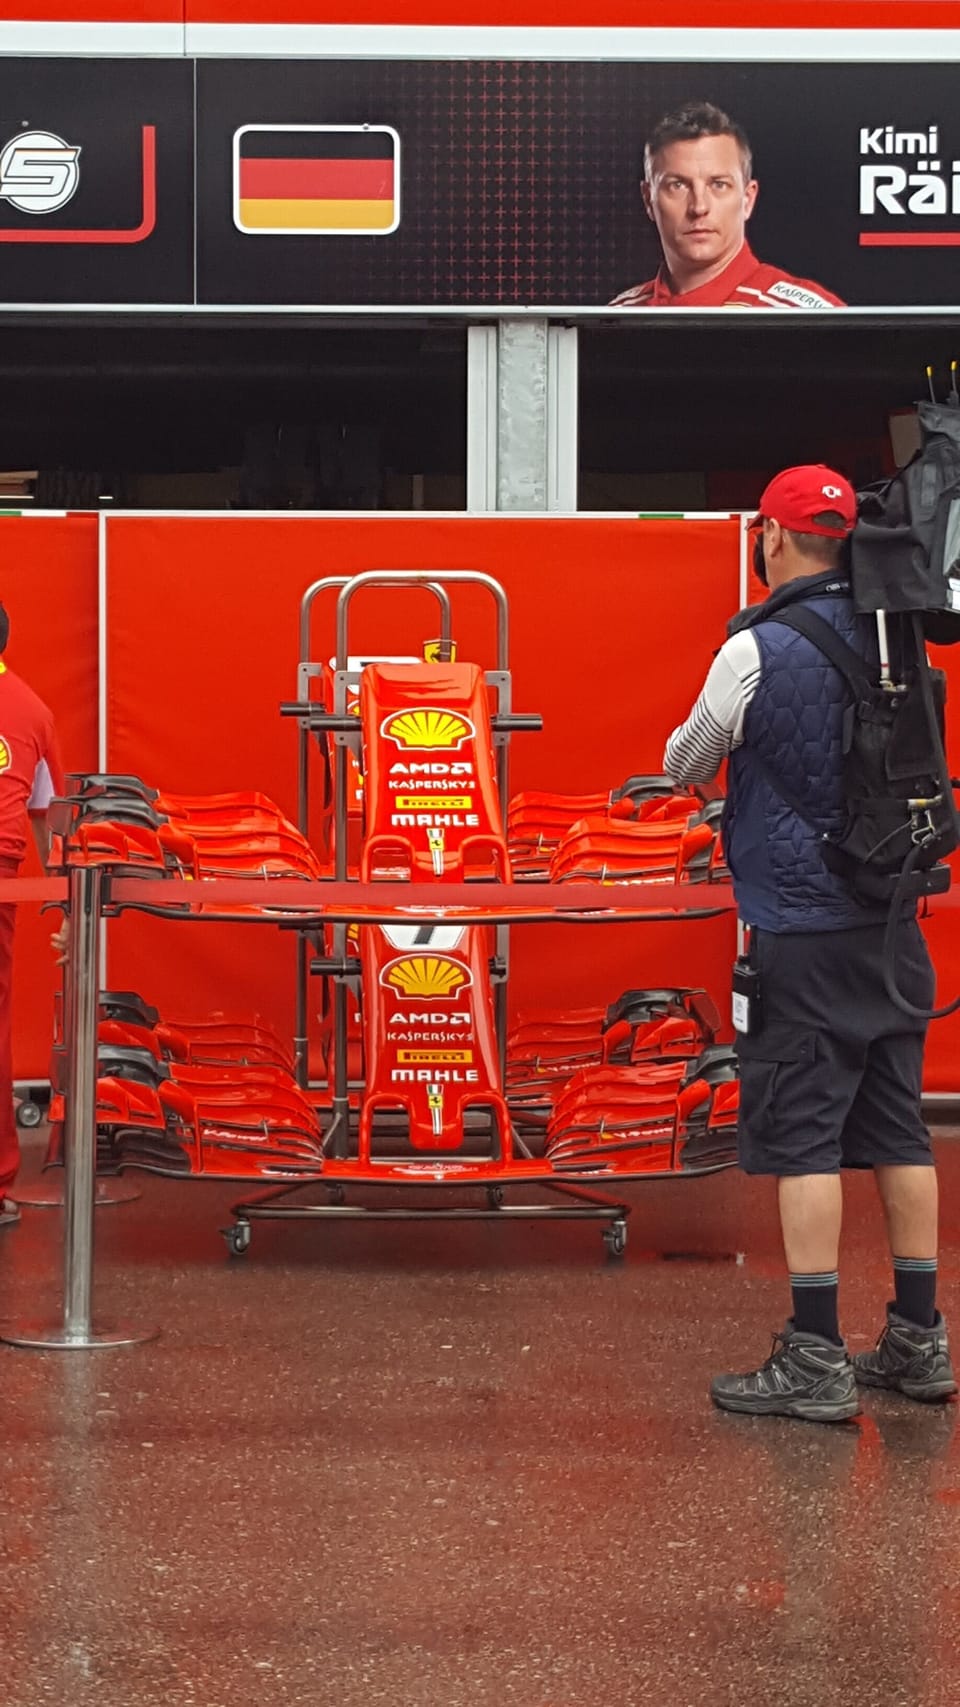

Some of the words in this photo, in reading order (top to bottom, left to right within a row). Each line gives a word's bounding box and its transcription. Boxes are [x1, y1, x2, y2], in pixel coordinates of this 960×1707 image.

[860, 126, 938, 154] Kimi
[389, 762, 450, 774] AMD
[391, 814, 479, 826] MAHLE
[389, 1012, 448, 1025] AMD
[387, 1031, 467, 1043] KASPERSKY
[391, 1069, 479, 1082] MAHLE
